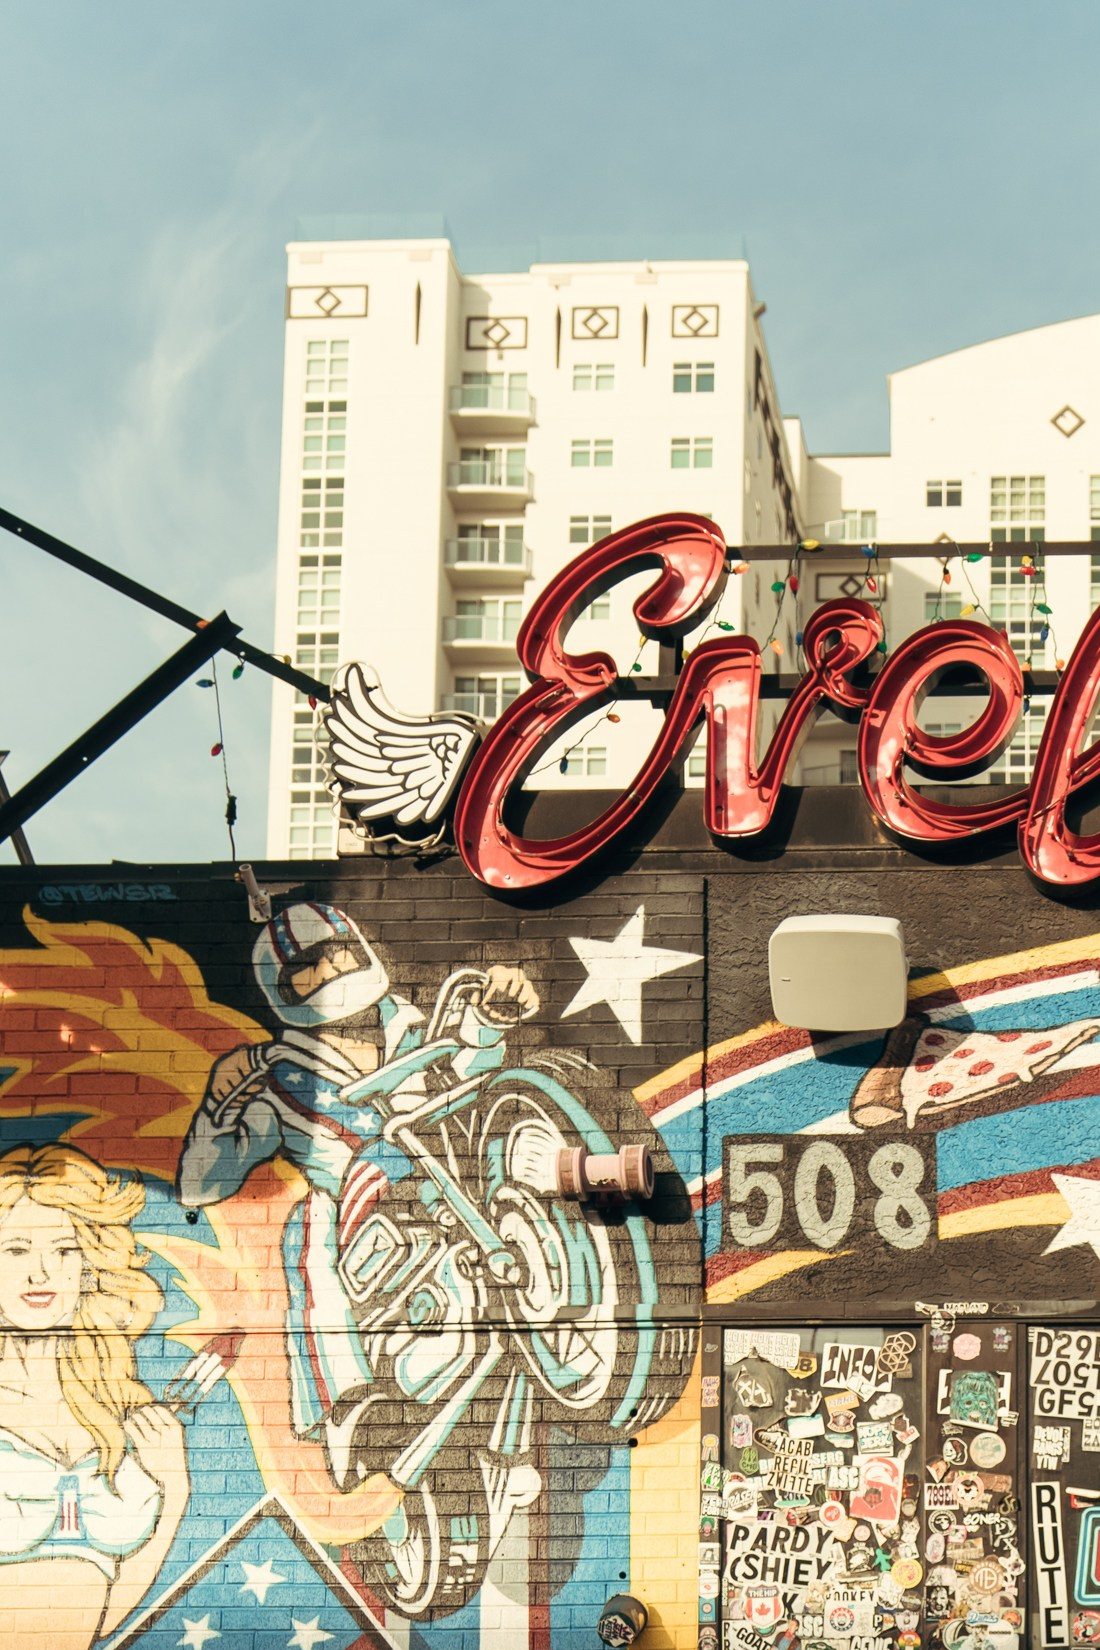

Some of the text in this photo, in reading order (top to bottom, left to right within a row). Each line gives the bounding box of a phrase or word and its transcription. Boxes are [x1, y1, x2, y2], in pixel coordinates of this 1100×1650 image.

[729, 1140, 932, 1250] 508
[779, 1438, 812, 1457] ACAB
[730, 1524, 833, 1554] PARDY
